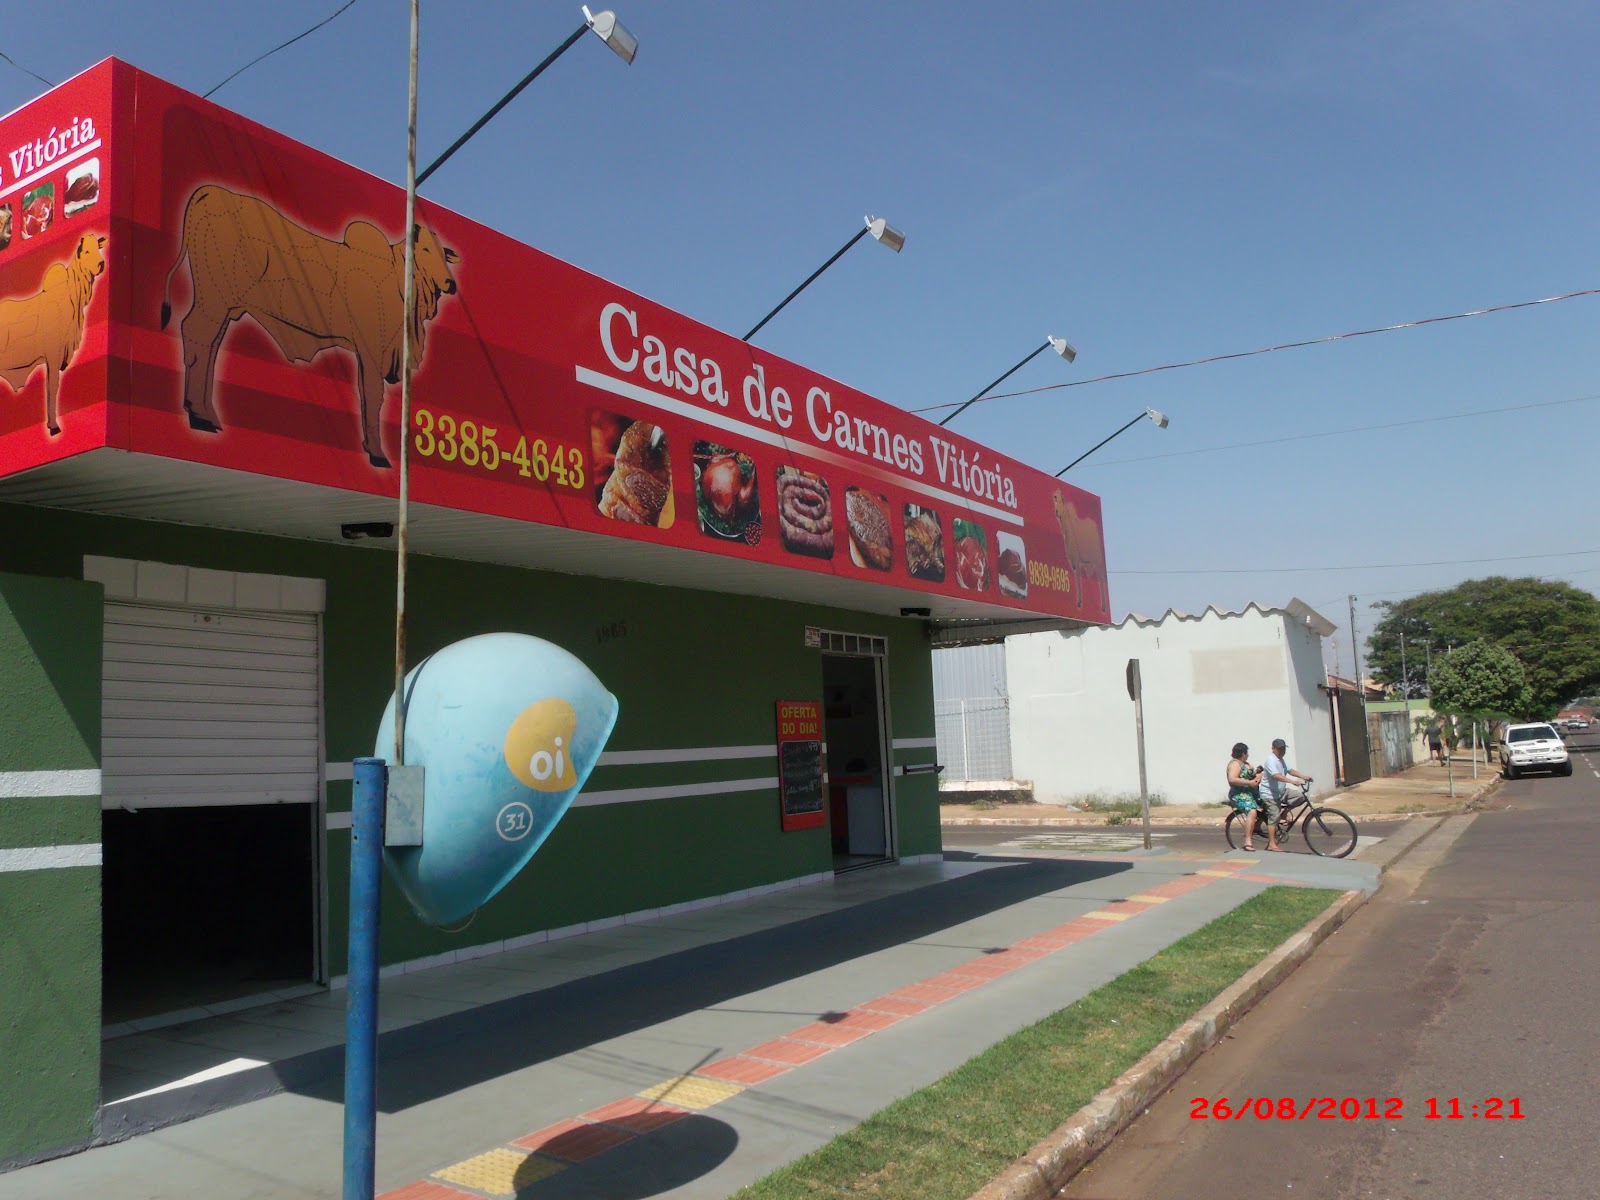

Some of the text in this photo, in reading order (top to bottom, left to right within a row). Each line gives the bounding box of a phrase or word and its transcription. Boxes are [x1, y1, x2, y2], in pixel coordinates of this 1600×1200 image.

[8, 116, 96, 179] Vitória
[599, 302, 1018, 509] Casa de Carnes Vitória
[414, 409, 585, 489] 3385-4643
[1028, 559, 1070, 593] 9839-9595
[781, 706, 817, 718] OFERTA
[782, 722, 818, 735] DO DIA!
[529, 736, 564, 781] oi
[504, 811, 526, 832] 31
